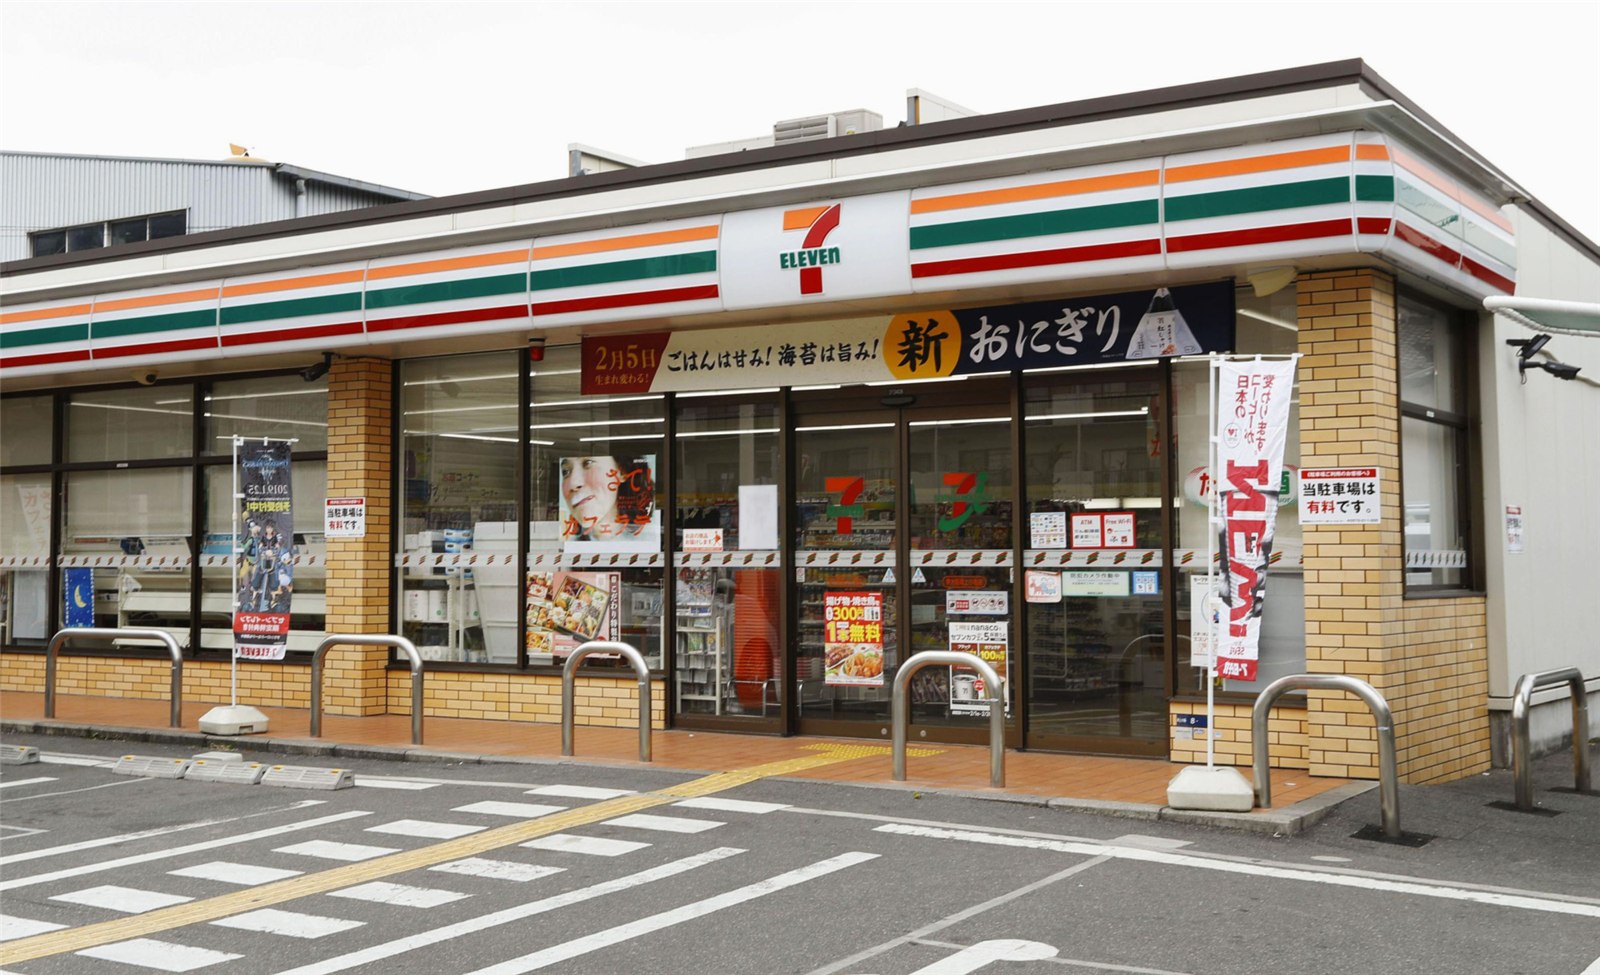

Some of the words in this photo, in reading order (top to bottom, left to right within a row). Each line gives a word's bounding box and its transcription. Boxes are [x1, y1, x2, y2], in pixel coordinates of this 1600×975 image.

[782, 203, 841, 294] 7
[897, 318, 949, 373] 新
[969, 304, 1121, 364] おにぎり
[595, 344, 657, 371] 2月5日
[605, 468, 652, 492] さて!
[1303, 482, 1375, 496] 当駐車場は
[1307, 500, 1371, 514] 有料です。
[562, 514, 652, 536] カフェラテ
